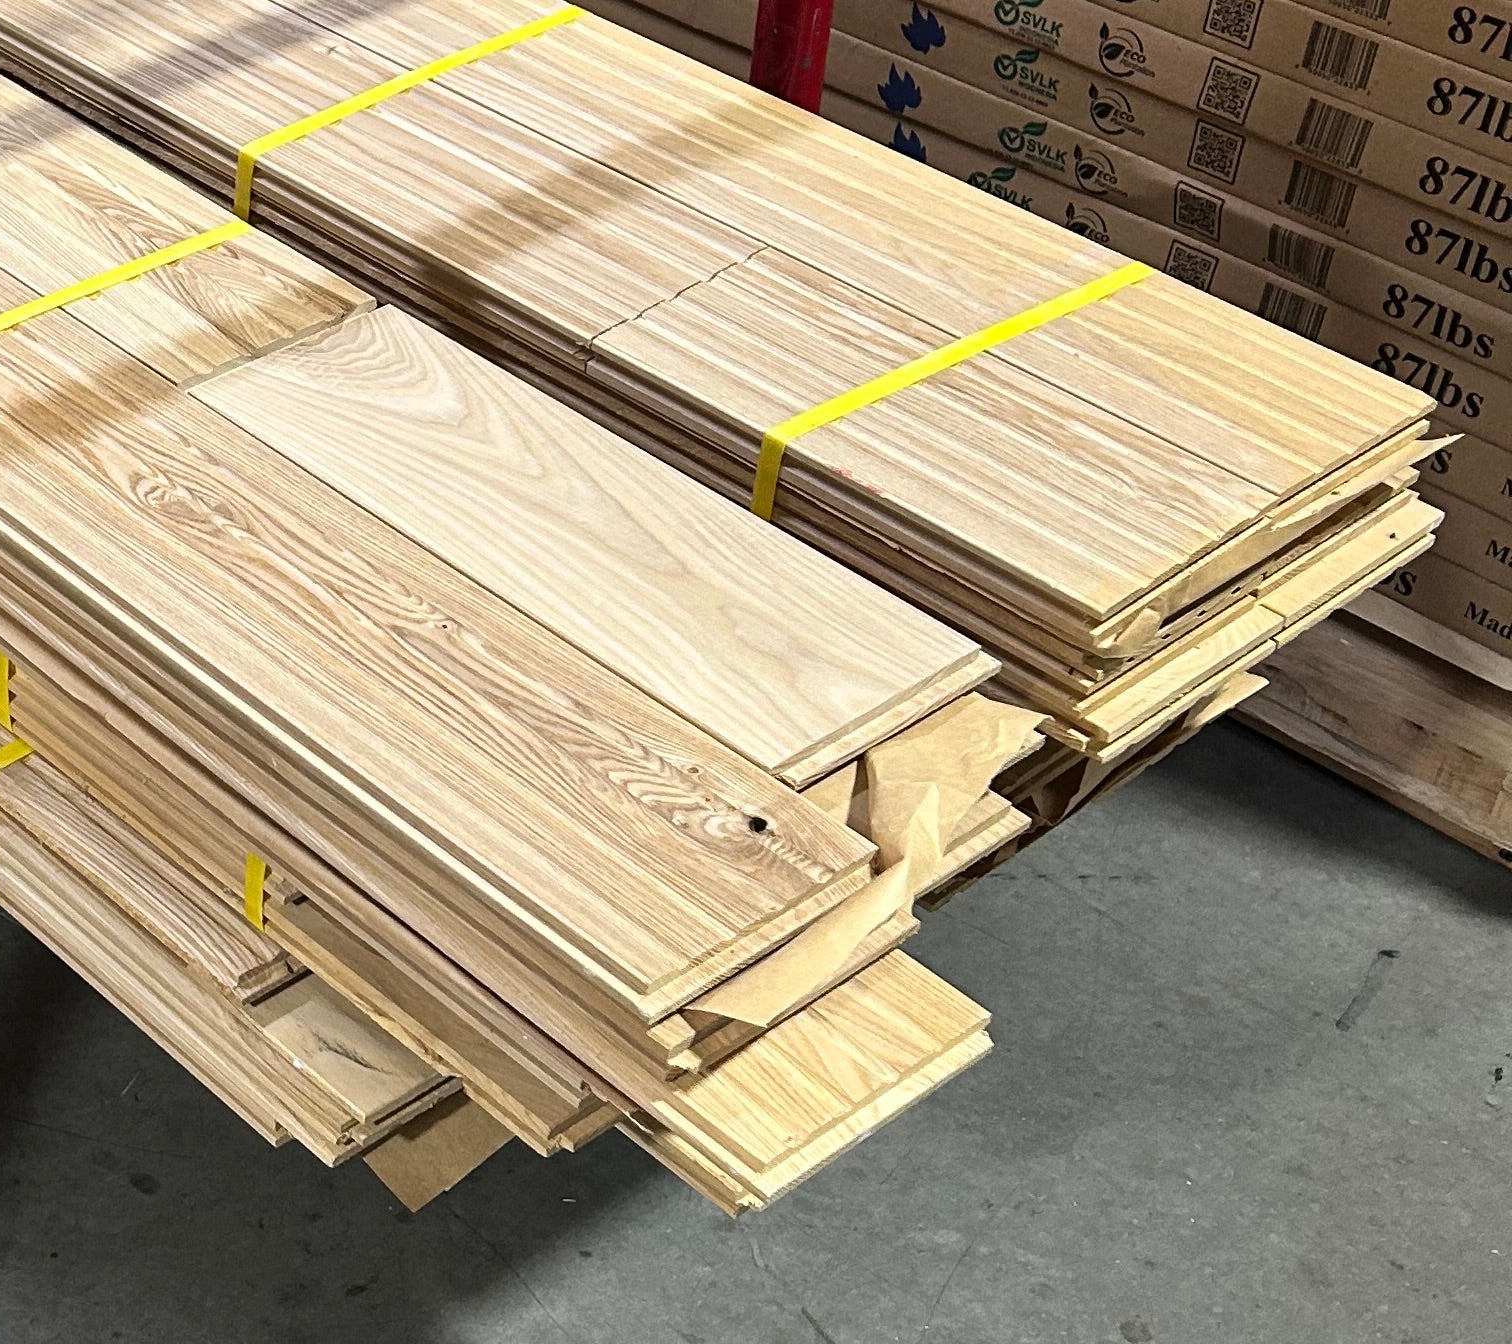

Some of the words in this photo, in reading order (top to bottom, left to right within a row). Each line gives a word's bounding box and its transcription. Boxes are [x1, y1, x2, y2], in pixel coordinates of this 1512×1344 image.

[1018, 66, 1060, 92] SVLK
[1382, 283, 1495, 360] 87lbs
[1370, 342, 1484, 418] 87lbs
